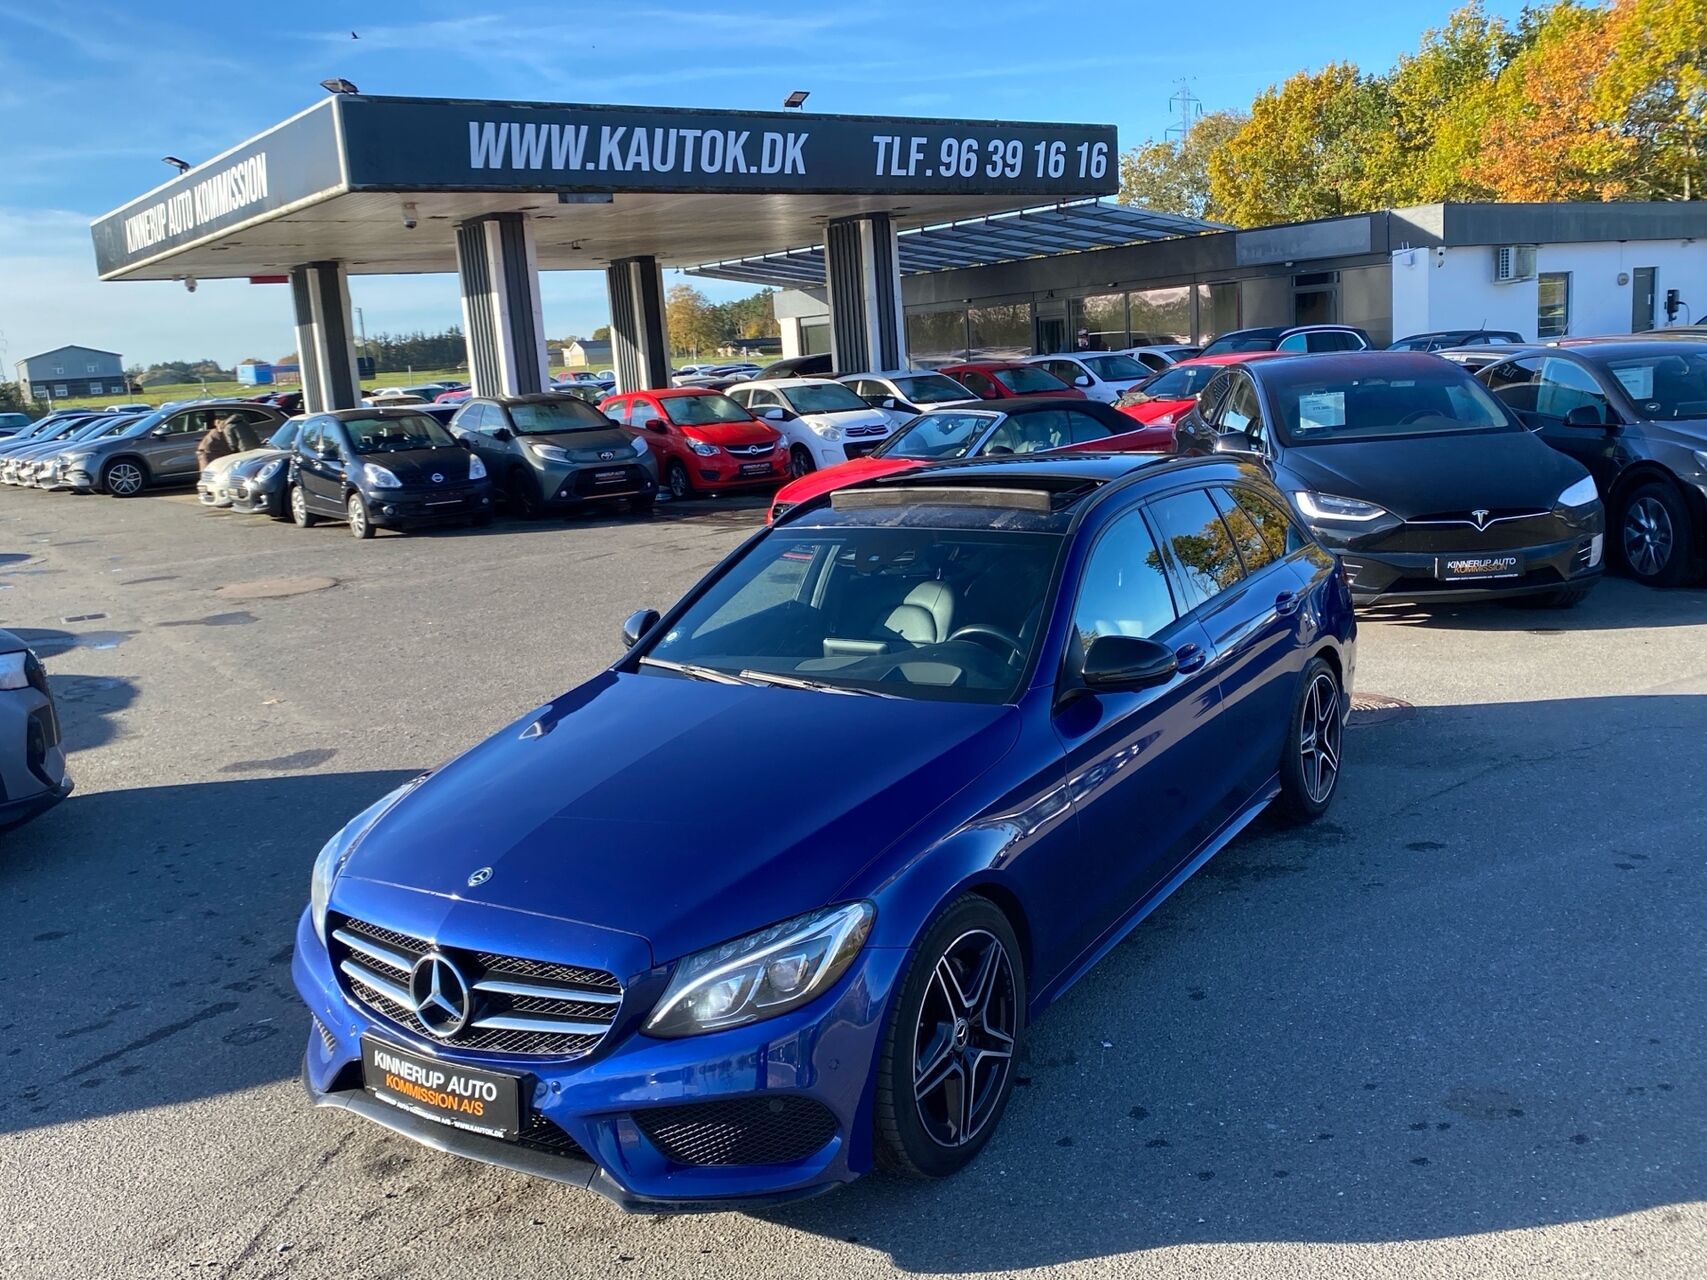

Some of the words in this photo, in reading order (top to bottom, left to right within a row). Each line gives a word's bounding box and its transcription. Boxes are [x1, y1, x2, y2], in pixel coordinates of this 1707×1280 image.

[468, 121, 809, 175] WWW.KAUTOK.DK
[872, 135, 933, 177] TLF.
[939, 137, 979, 178] 96
[985, 139, 1024, 179] 39
[1034, 140, 1067, 179] 16
[1076, 141, 1109, 179] 16
[125, 203, 167, 253] KINNERUP
[168, 190, 194, 236] AUTO
[194, 152, 268, 225] KOMMISSION
[1447, 559, 1492, 568] KINNERUP
[1492, 557, 1516, 566] AUTO
[1454, 563, 1508, 573] KOMMISSION
[374, 1050, 445, 1088] KINNERUP
[446, 1075, 497, 1102] AUTO
[385, 1073, 459, 1111] KOMMISSION
[460, 1099, 484, 1116] A/S
